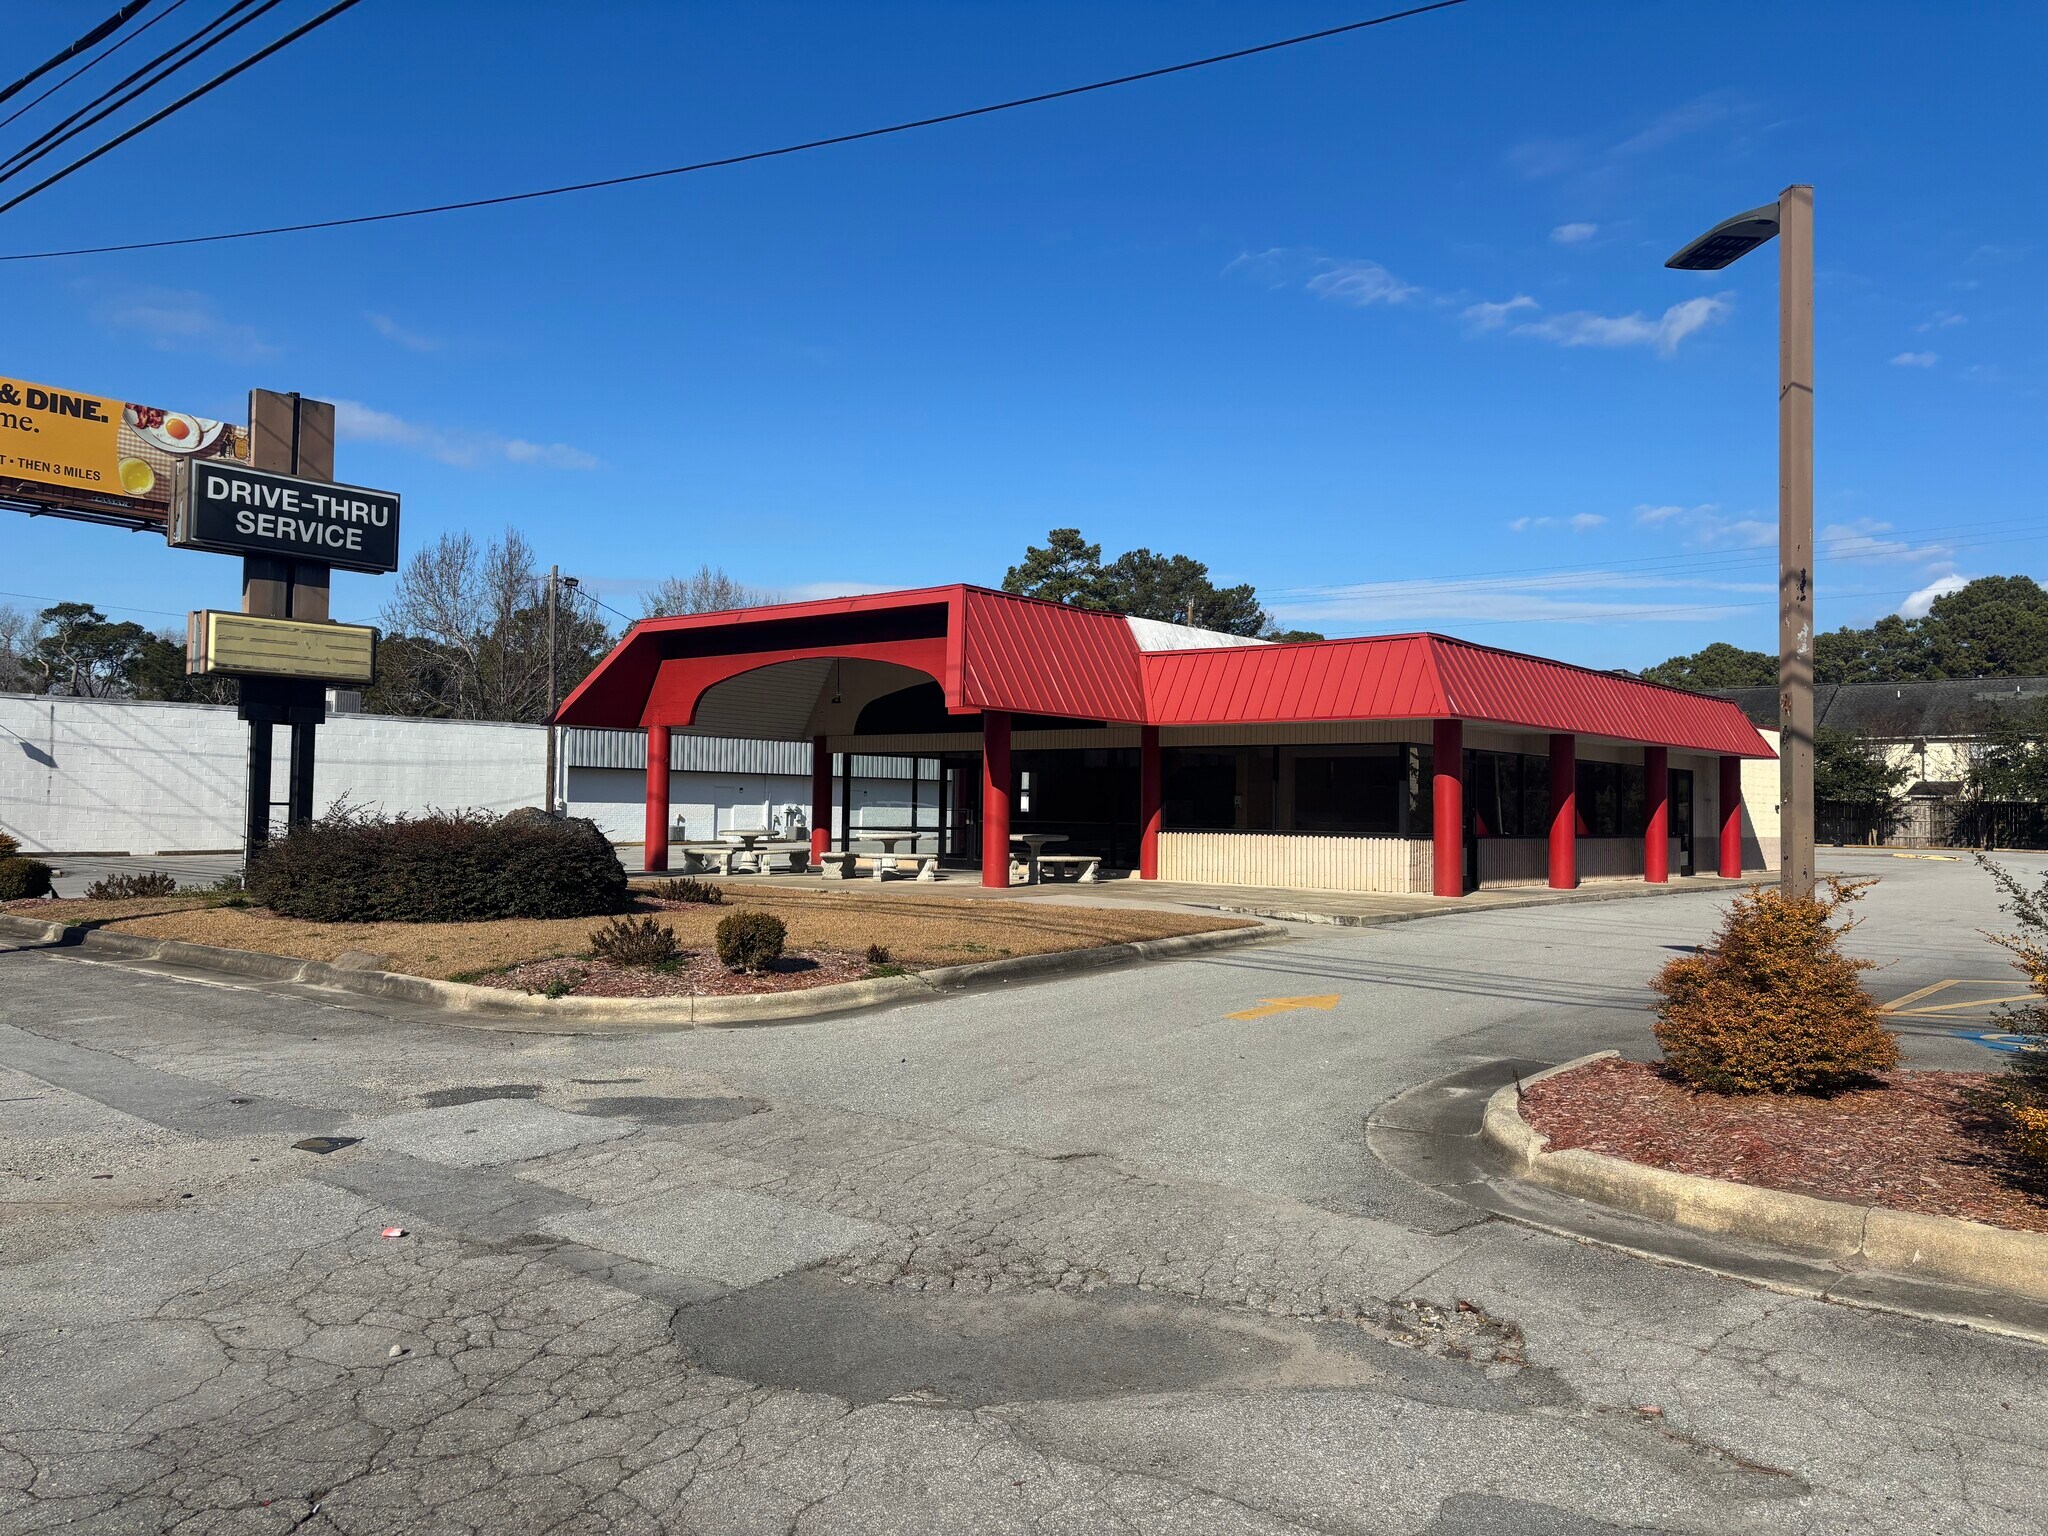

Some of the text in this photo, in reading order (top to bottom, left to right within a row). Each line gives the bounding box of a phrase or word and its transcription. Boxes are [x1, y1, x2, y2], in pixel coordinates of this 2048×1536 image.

[0, 383, 109, 423] & DINE.
[17, 457, 51, 472] THEN
[53, 464, 61, 475] 3
[64, 466, 101, 481] MILES
[207, 476, 388, 526] DRIVE-THRU
[235, 511, 362, 550] SERVICE
